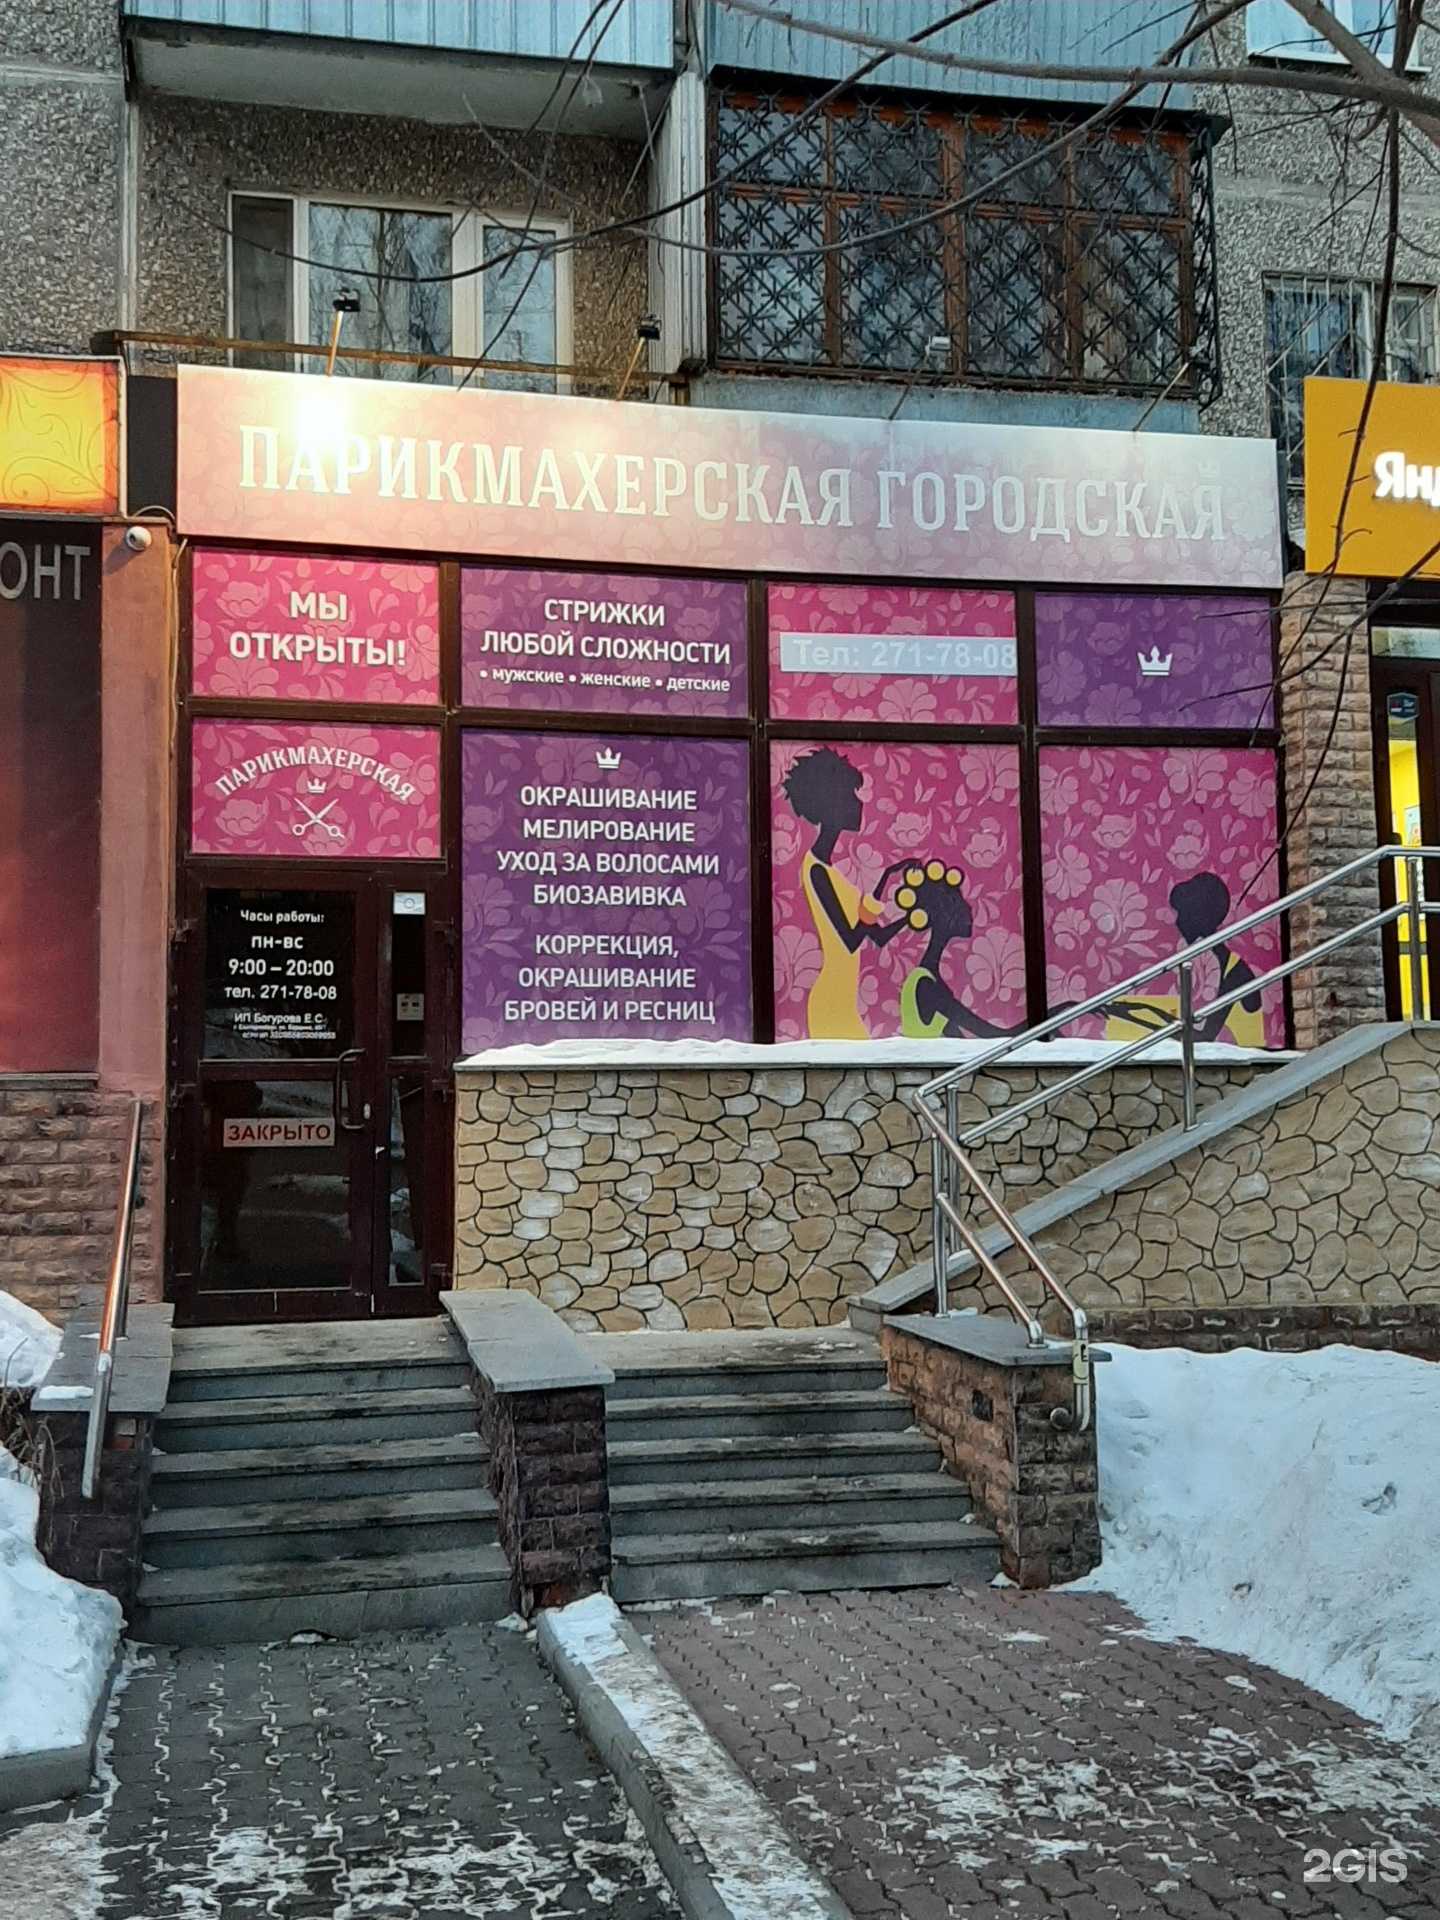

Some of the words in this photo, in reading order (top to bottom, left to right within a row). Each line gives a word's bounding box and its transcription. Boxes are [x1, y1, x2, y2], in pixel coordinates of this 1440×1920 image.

[238, 424, 853, 529] ПАРИКМАХЕРСКАЯ
[876, 466, 1225, 545] ГОРОДСКАЯ
[289, 591, 348, 622] МЫ
[543, 600, 666, 627] СТРИЖКИ
[229, 632, 406, 666] ОТКРЫТЫ!
[480, 630, 574, 659] ЛЮБОЙ
[580, 637, 731, 666] СЛОЖНОСТИ
[792, 640, 862, 669] Тел:
[870, 640, 1017, 670] 271-78-08
[492, 669, 564, 686] мужские
[580, 672, 651, 689] женские
[666, 677, 731, 693] детские
[214, 746, 416, 801] ПАРИКМАХЕРСКАЯ
[520, 786, 697, 810] ОКРАШИВАНИЕ
[523, 818, 696, 843] МЕЛИРОВАНИЕ
[497, 851, 558, 876] УХОД
[562, 853, 592, 873] ЗА
[596, 853, 720, 876] ВОЛОСАМИ
[533, 884, 688, 907] БИОЗАВИВКА
[240, 909, 274, 923] Часы
[276, 911, 325, 925] работы:
[535, 934, 680, 960] КОРРЕКЦИЯ,
[228, 958, 267, 976] 9:00
[286, 959, 335, 977] 20:00
[518, 967, 697, 989] ОКРАШИВАНИЕ
[224, 986, 256, 999] тел.
[260, 985, 337, 1000] 271-78-08
[504, 996, 597, 1022] БРОВЕЙ
[603, 1002, 619, 1022] И
[625, 1001, 716, 1025] РЕСНИЦ
[227, 1123, 332, 1142] ЗАКРЫТО
